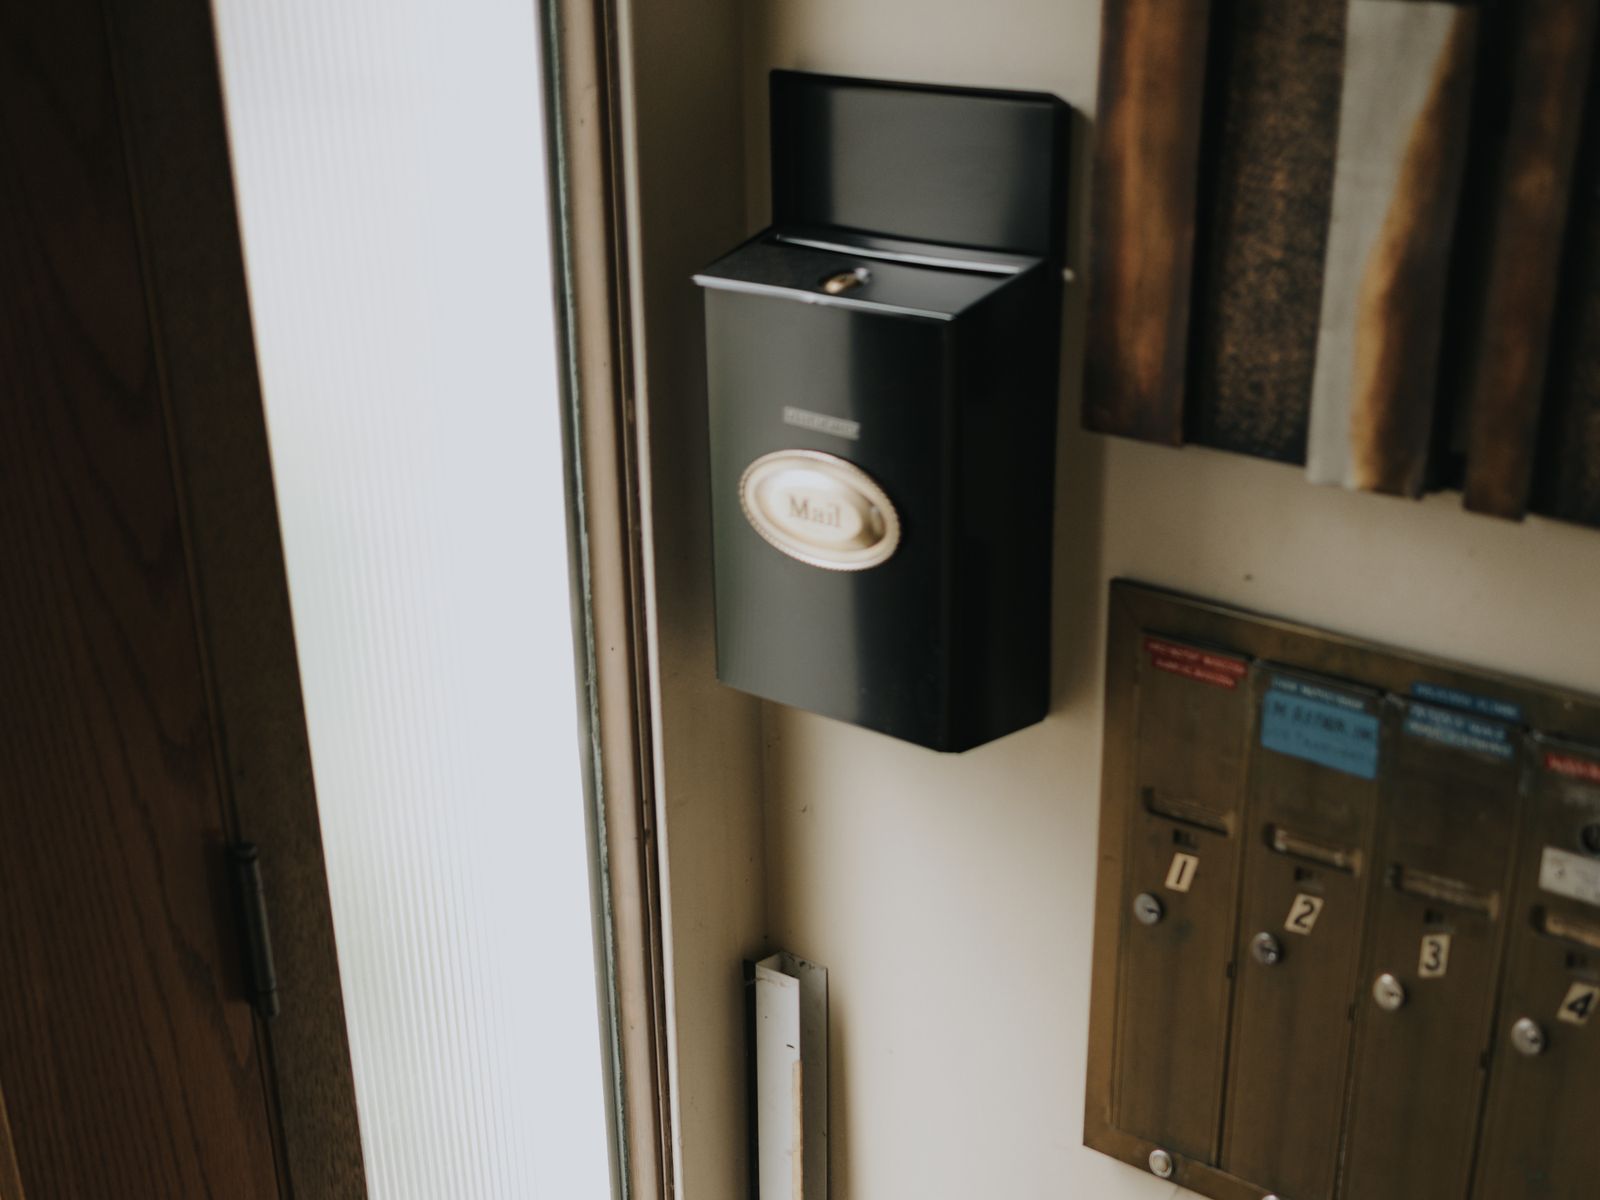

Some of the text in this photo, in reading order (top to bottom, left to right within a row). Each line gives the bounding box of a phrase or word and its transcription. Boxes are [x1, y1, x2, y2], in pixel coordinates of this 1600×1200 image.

[788, 494, 842, 528] Mail
[1175, 858, 1188, 885] 1
[1293, 900, 1315, 928] 2
[1424, 940, 1441, 971] 3
[1566, 992, 1595, 1019] 4
